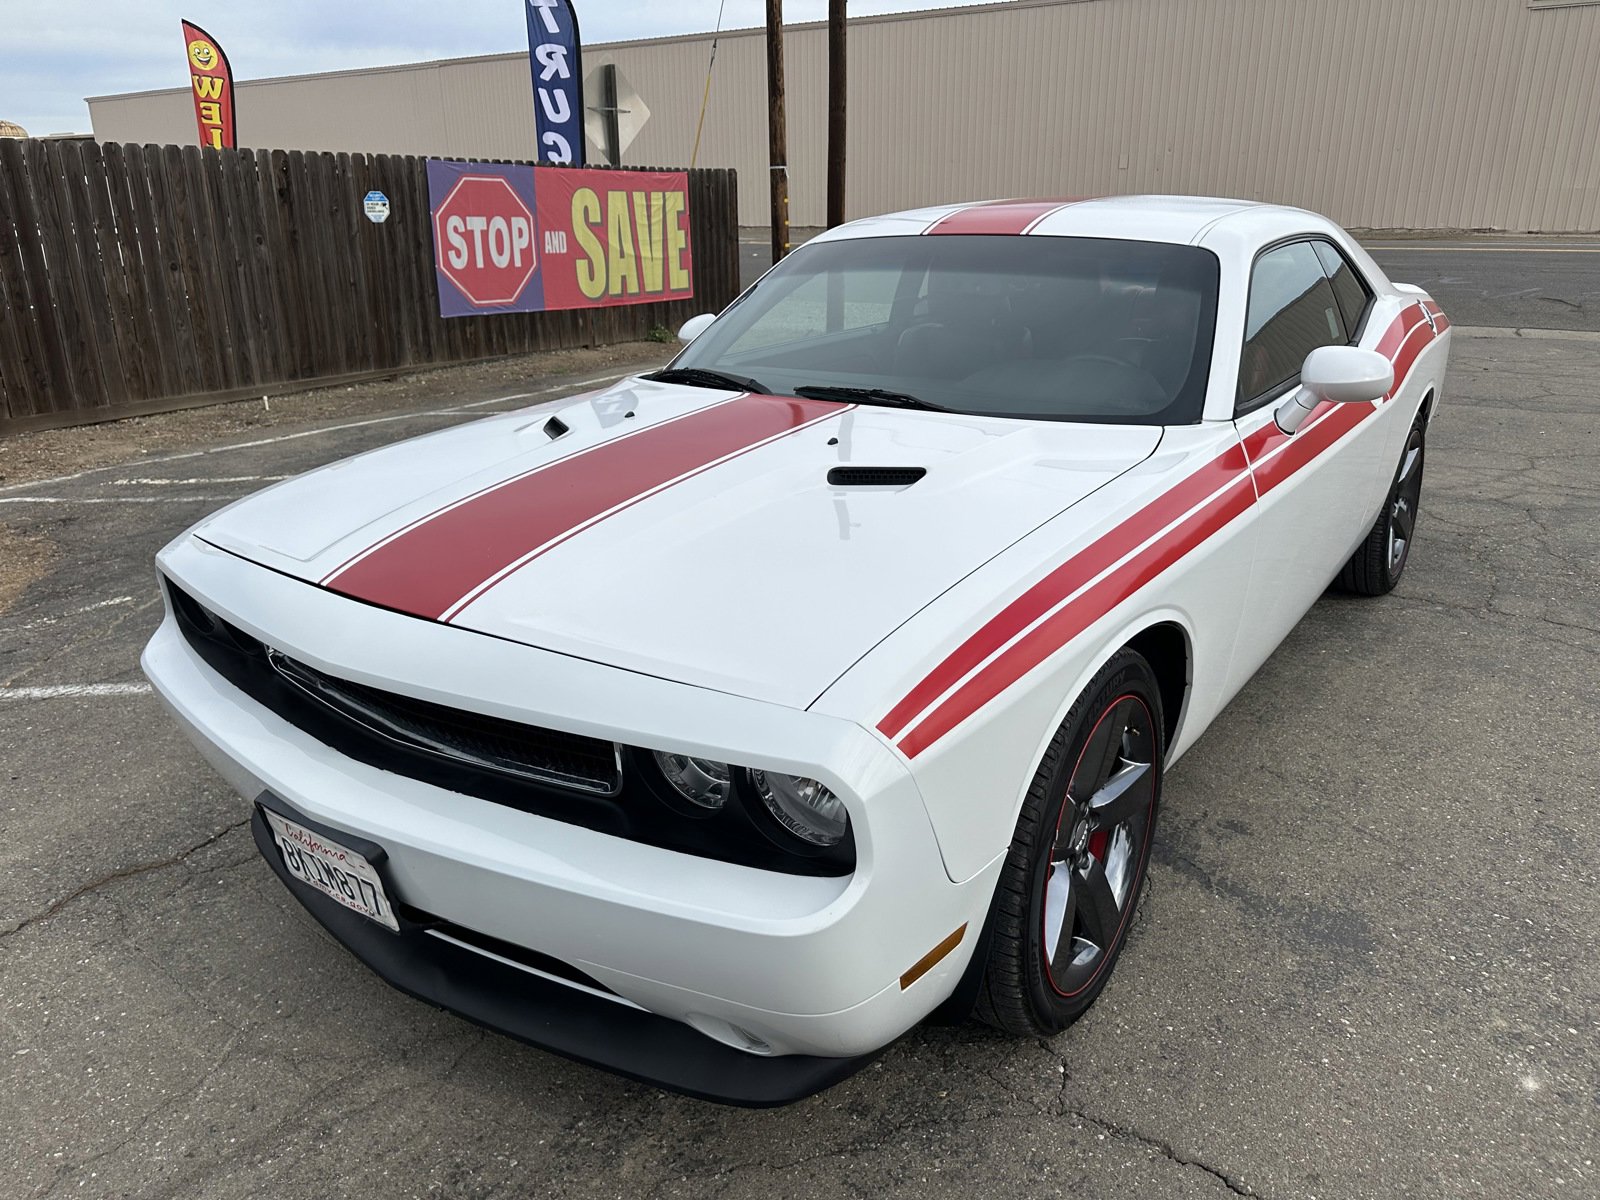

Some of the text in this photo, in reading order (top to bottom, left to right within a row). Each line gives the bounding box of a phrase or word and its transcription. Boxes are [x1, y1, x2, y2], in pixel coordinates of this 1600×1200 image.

[446, 187, 690, 299] STOP AND SAVE
[284, 823, 350, 865] California
